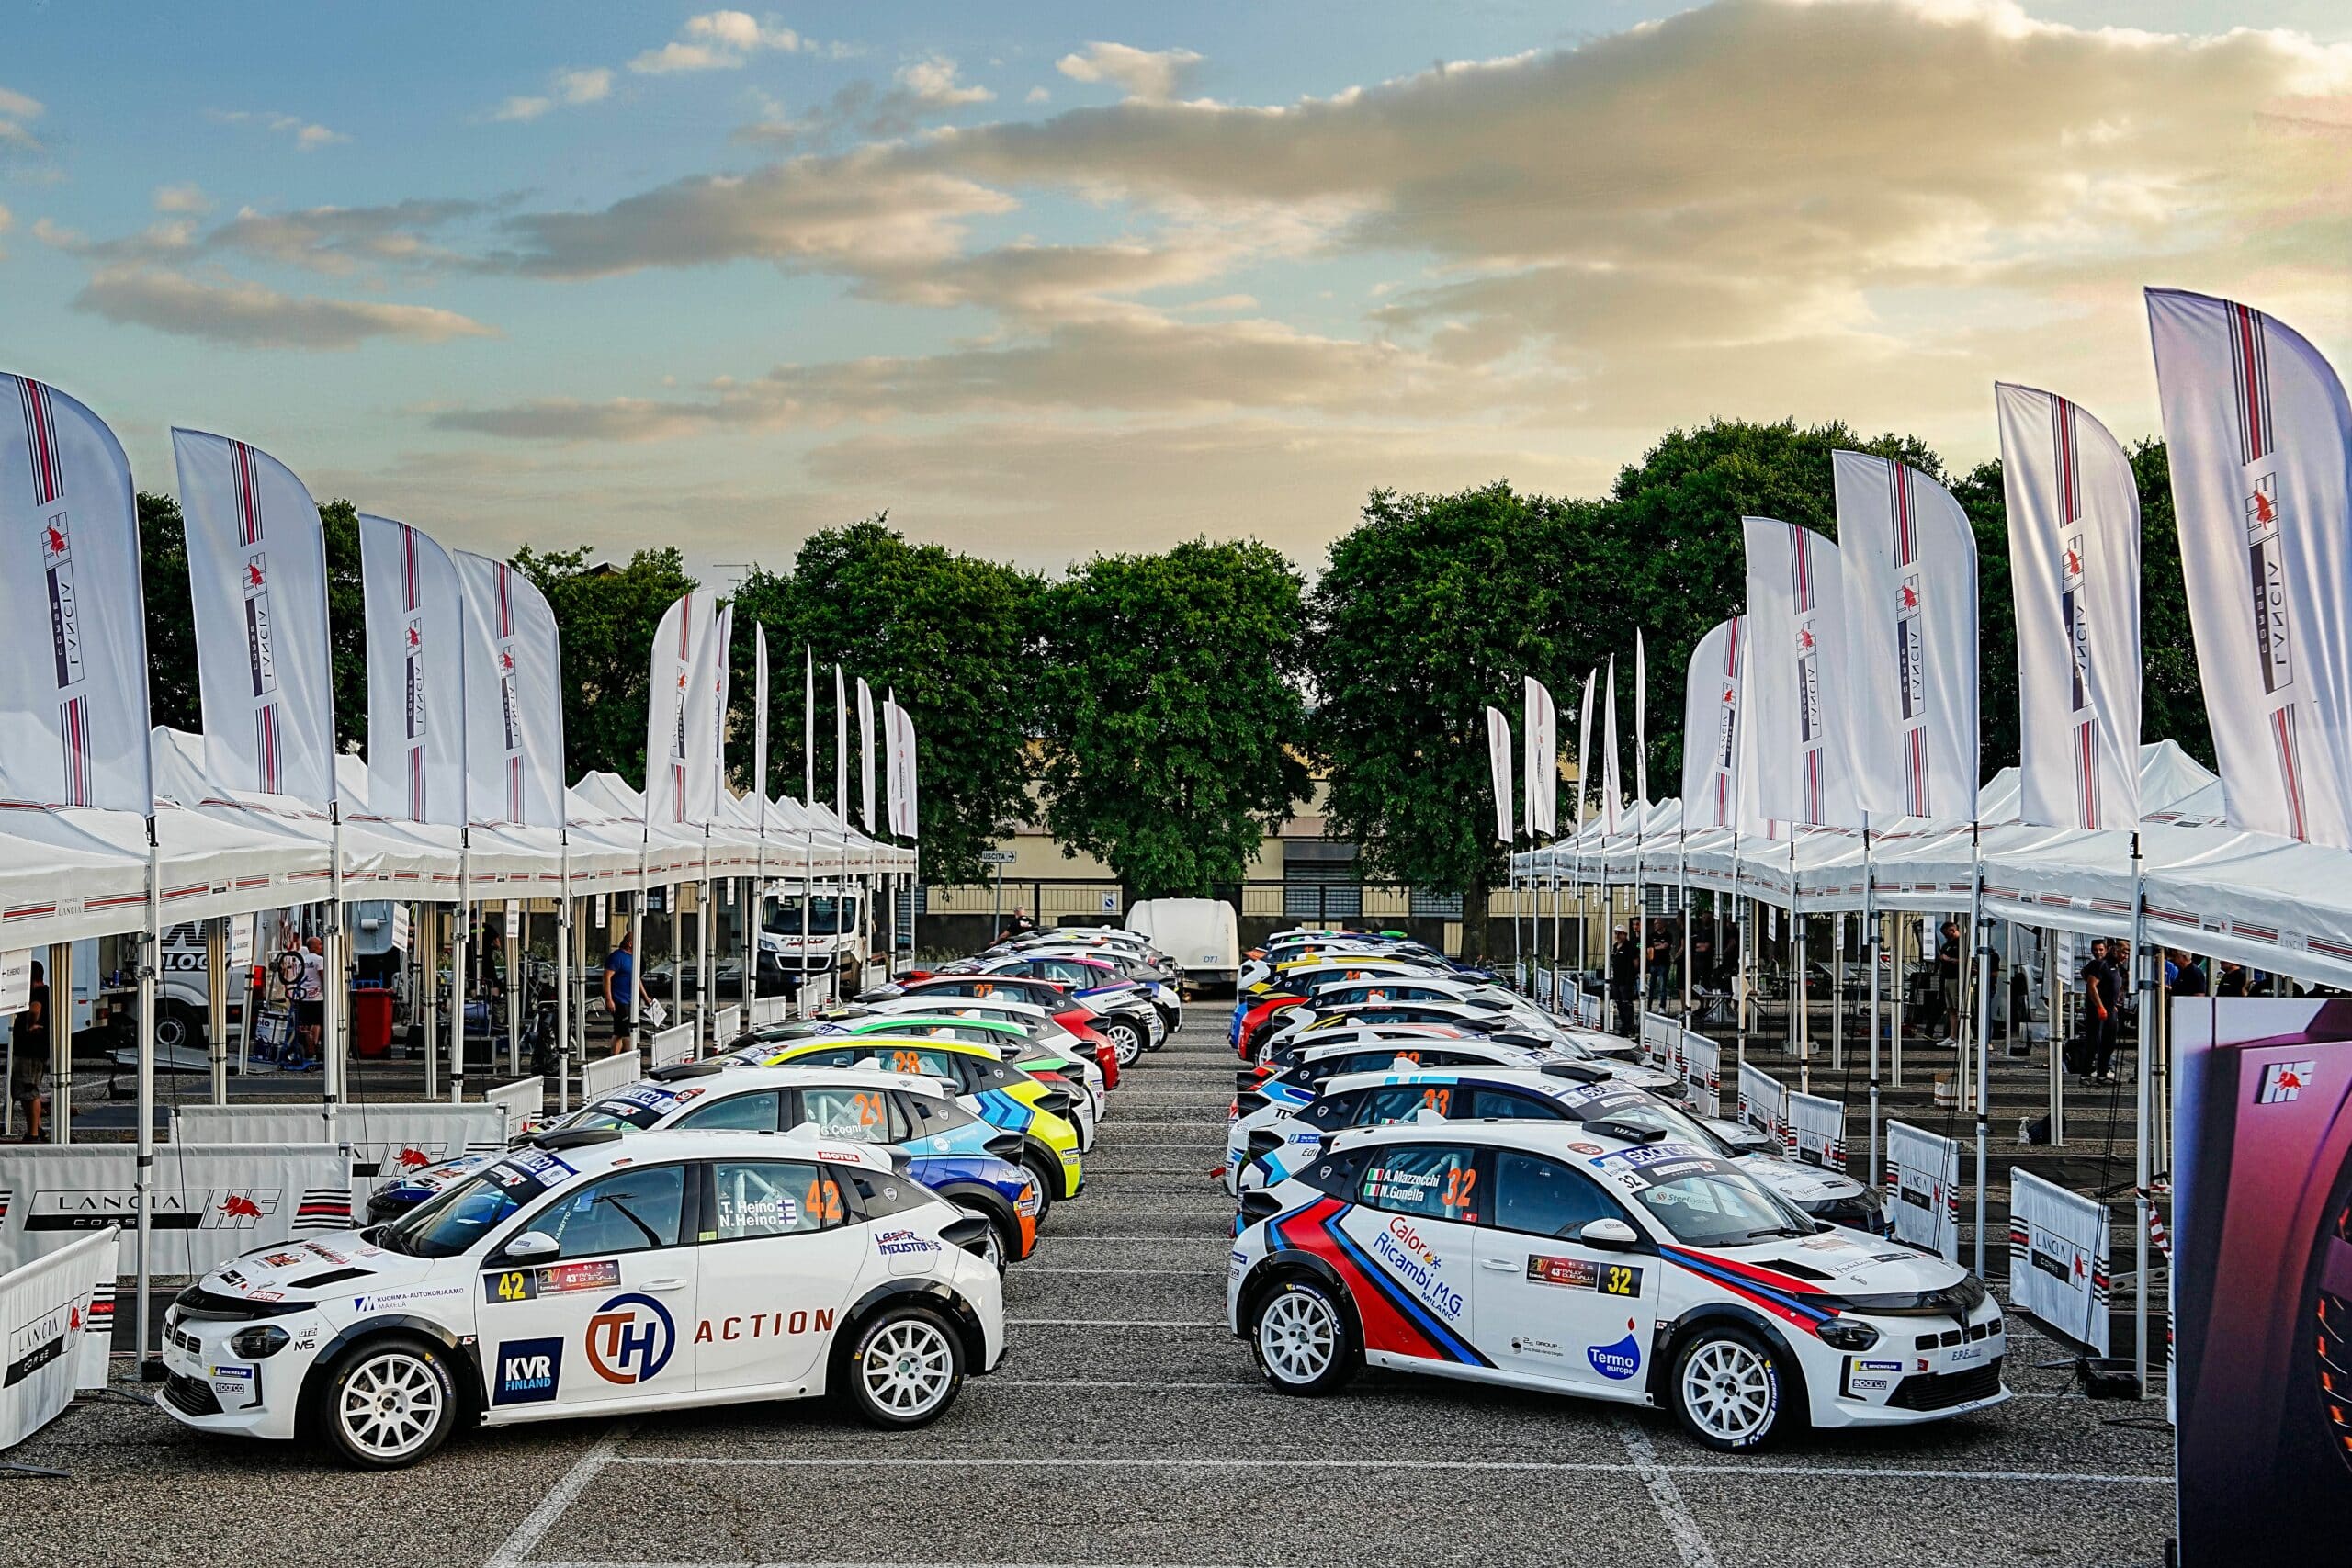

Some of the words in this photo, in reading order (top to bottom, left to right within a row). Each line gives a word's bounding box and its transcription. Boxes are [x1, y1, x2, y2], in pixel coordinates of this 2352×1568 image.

[983, 852, 1005, 860] USCITA
[58, 906, 82, 917] LANCIA
[975, 984, 994, 998] 27
[892, 1051, 922, 1074] 28
[2261, 1060, 2317, 1104] HF
[854, 1093, 884, 1126] 21
[820, 1123, 862, 1137] G.Cogni
[820, 1152, 859, 1161] MOTUL
[1625, 1145, 1693, 1164] sparco
[1383, 1168, 1441, 1188] A.Mazzocchi
[1442, 1168, 1476, 1207] 32
[1617, 1174, 1642, 1190] 32
[805, 1179, 842, 1220] 42
[1379, 1184, 1425, 1201] N.Gonella
[59, 1195, 181, 1210] LANCIA
[720, 1201, 734, 1214] T.
[737, 1200, 775, 1213] Heino
[719, 1213, 777, 1227] N.Heino
[874, 1230, 917, 1244] LASER
[1389, 1216, 1427, 1255] Calor
[878, 1240, 943, 1256] INDUSTRIES
[2035, 1232, 2066, 1259] LANCIA
[1373, 1231, 1434, 1291] Ricambi
[1433, 1281, 1464, 1317] M.G.
[1607, 1266, 1632, 1294] 32
[498, 1272, 526, 1301] 42
[1420, 1292, 1455, 1321] MILANO
[19, 1316, 58, 1353] LANCIA
[694, 1308, 835, 1345] ACTION
[1535, 1340, 1558, 1348] GROUP
[1590, 1348, 1634, 1368] Termo
[221, 1368, 248, 1377] MICHELIN
[505, 1355, 551, 1381] KVR
[1606, 1365, 1634, 1376] europa
[215, 1382, 244, 1393] sparco
[505, 1377, 552, 1392] FINLAND
[1852, 1379, 1886, 1388] sparco
